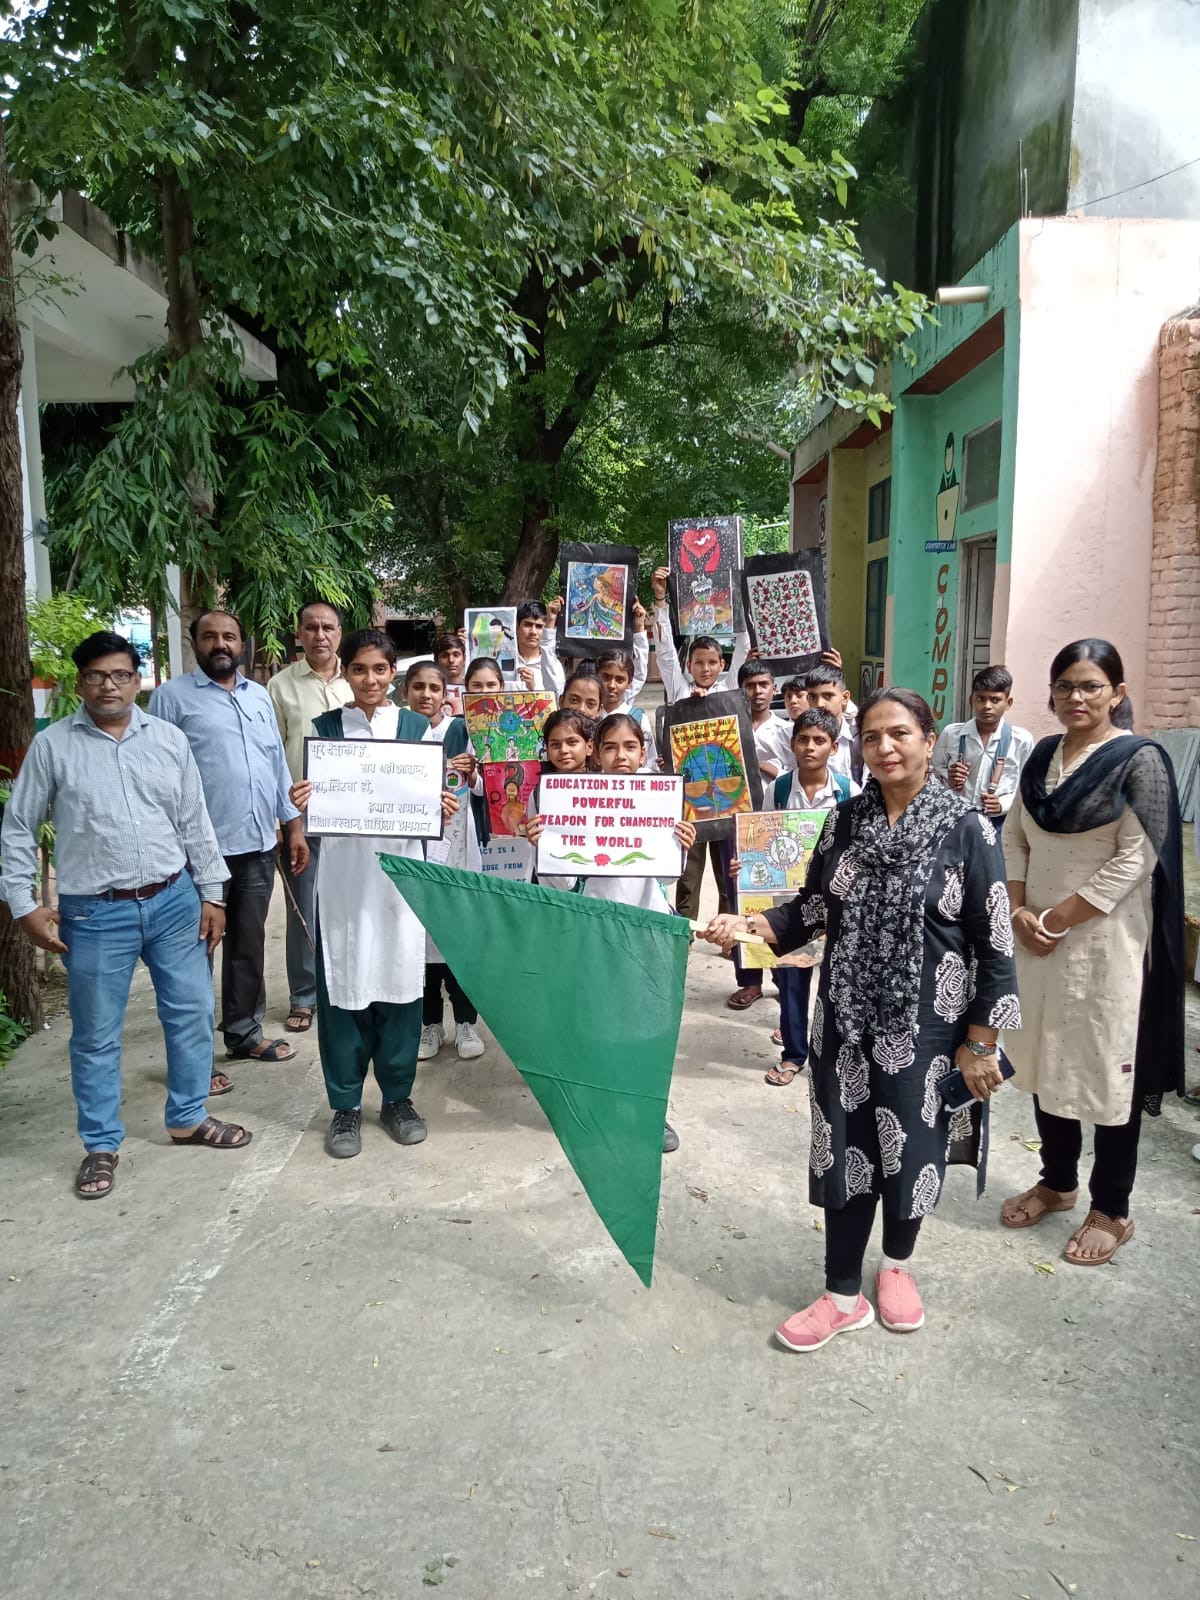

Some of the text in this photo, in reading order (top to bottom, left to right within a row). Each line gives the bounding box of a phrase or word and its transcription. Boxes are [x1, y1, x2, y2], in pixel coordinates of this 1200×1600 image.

[546, 778, 677, 792] EDUCATION IS THE MOST
[572, 797, 636, 809] POWERFUL
[539, 815, 675, 828] WEAPON FOR CHANGING
[561, 835, 643, 848] THE WORLD
